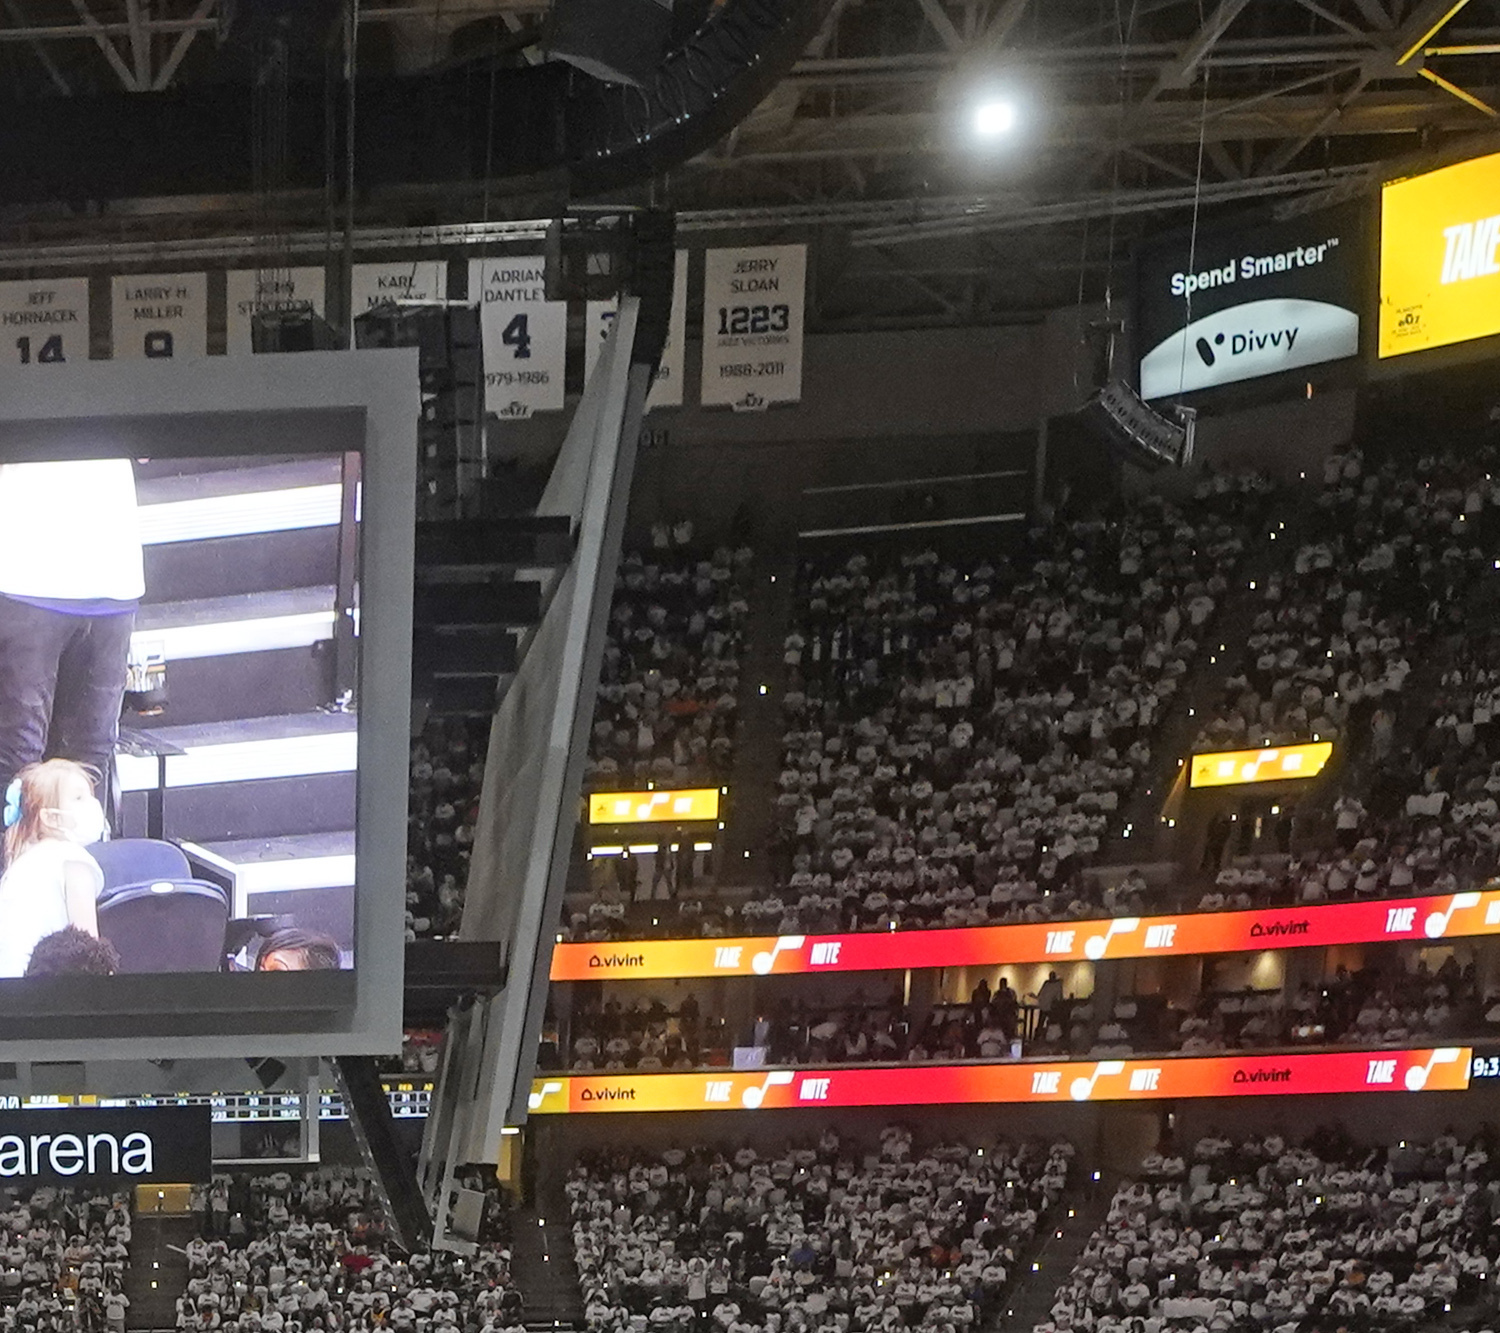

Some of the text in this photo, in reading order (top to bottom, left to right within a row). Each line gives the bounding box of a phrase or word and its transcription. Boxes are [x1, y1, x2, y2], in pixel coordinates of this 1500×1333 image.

[734, 258, 779, 275] JERRY
[376, 274, 416, 290] KARL
[731, 276, 780, 295] SLOAN
[1170, 263, 1237, 299] Spend
[26, 290, 54, 307] JEFF
[124, 285, 171, 303] LARRY
[2, 307, 79, 325] HORNACEK
[133, 303, 184, 321] MILLER
[718, 304, 790, 336] 1223
[501, 313, 531, 358] 4
[1231, 326, 1300, 362] Divvy
[15, 336, 67, 365] 14
[485, 369, 549, 386] 979-1986
[600, 953, 645, 968] vivint
[595, 1087, 636, 1101] vivint
